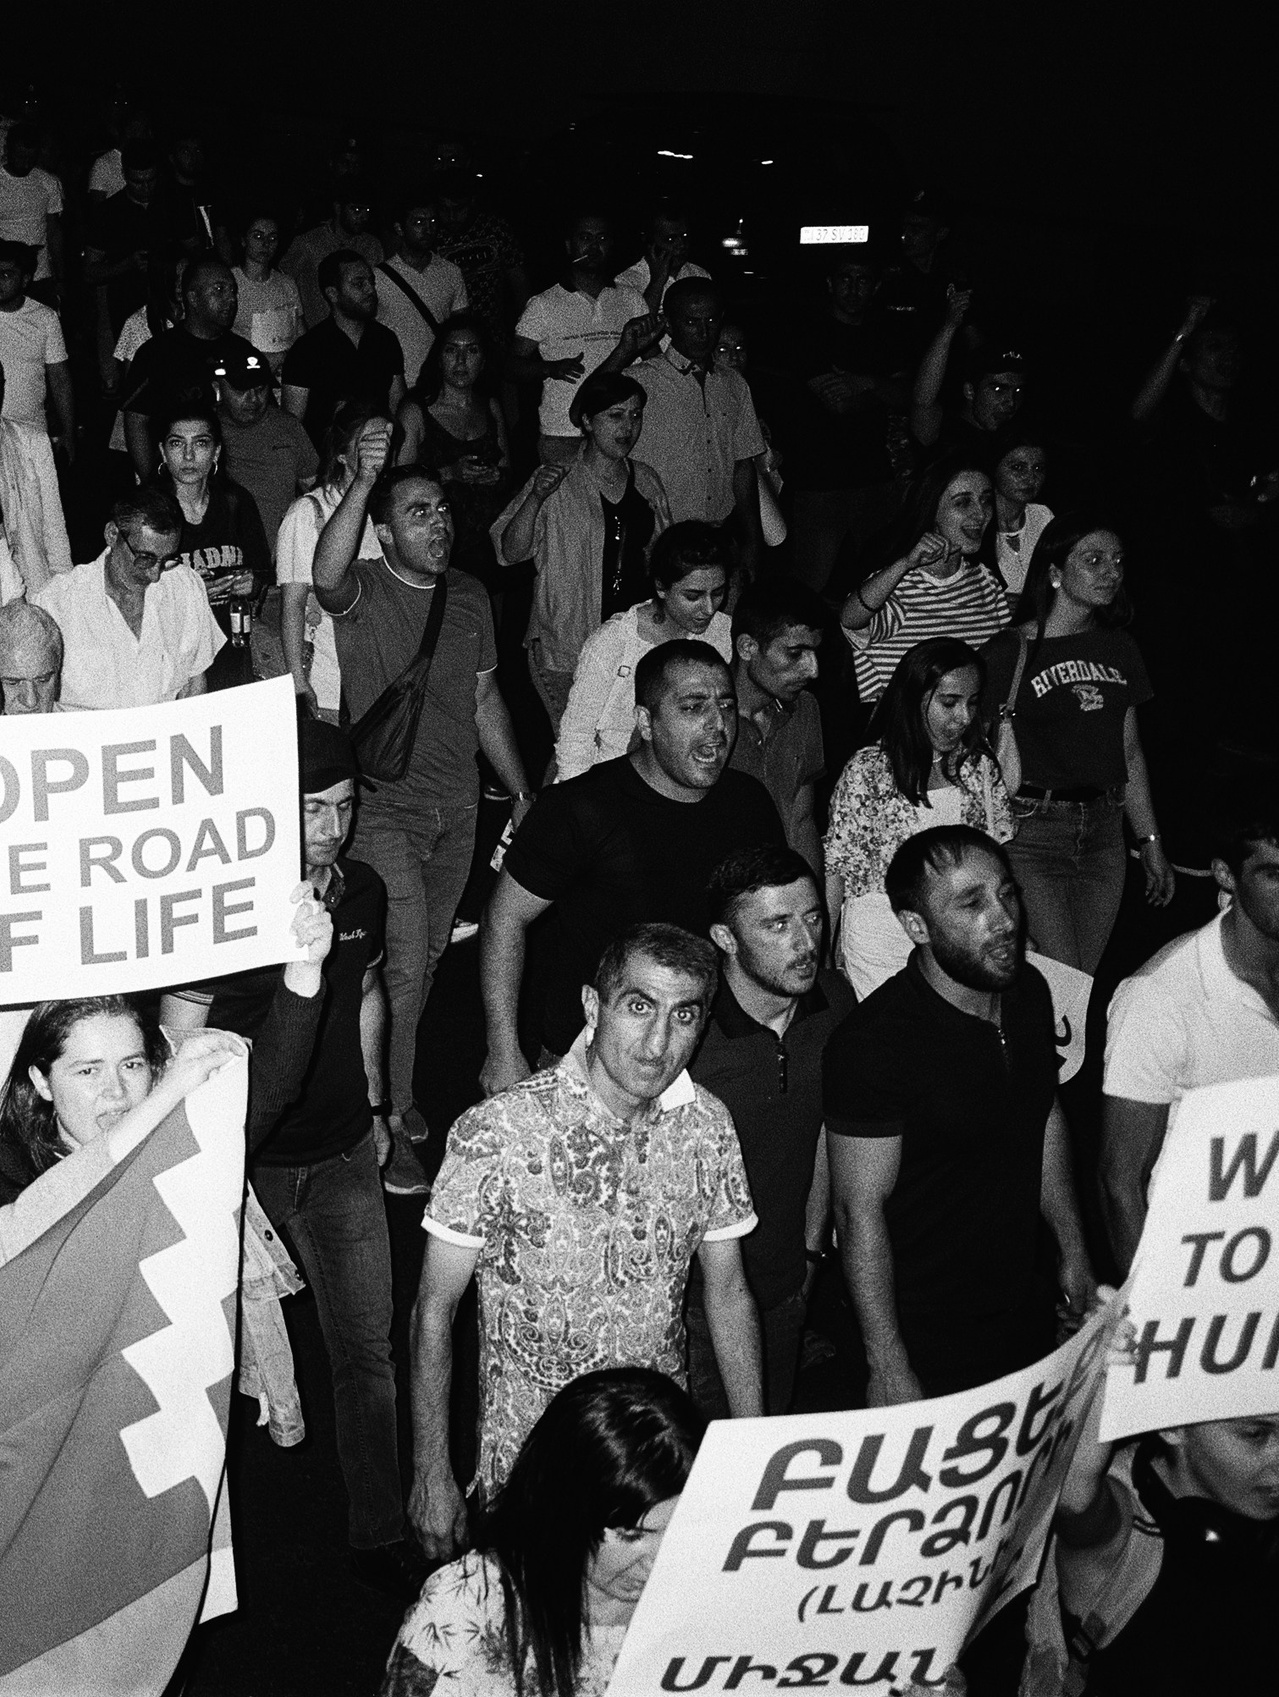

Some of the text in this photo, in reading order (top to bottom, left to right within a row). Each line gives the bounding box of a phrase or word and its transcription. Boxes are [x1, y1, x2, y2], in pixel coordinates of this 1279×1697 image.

[1031, 659, 1128, 698] RIVERDALE
[79, 806, 277, 888] ROAD
[79, 876, 259, 967] LIFE
[1180, 1226, 1271, 1288] TO
